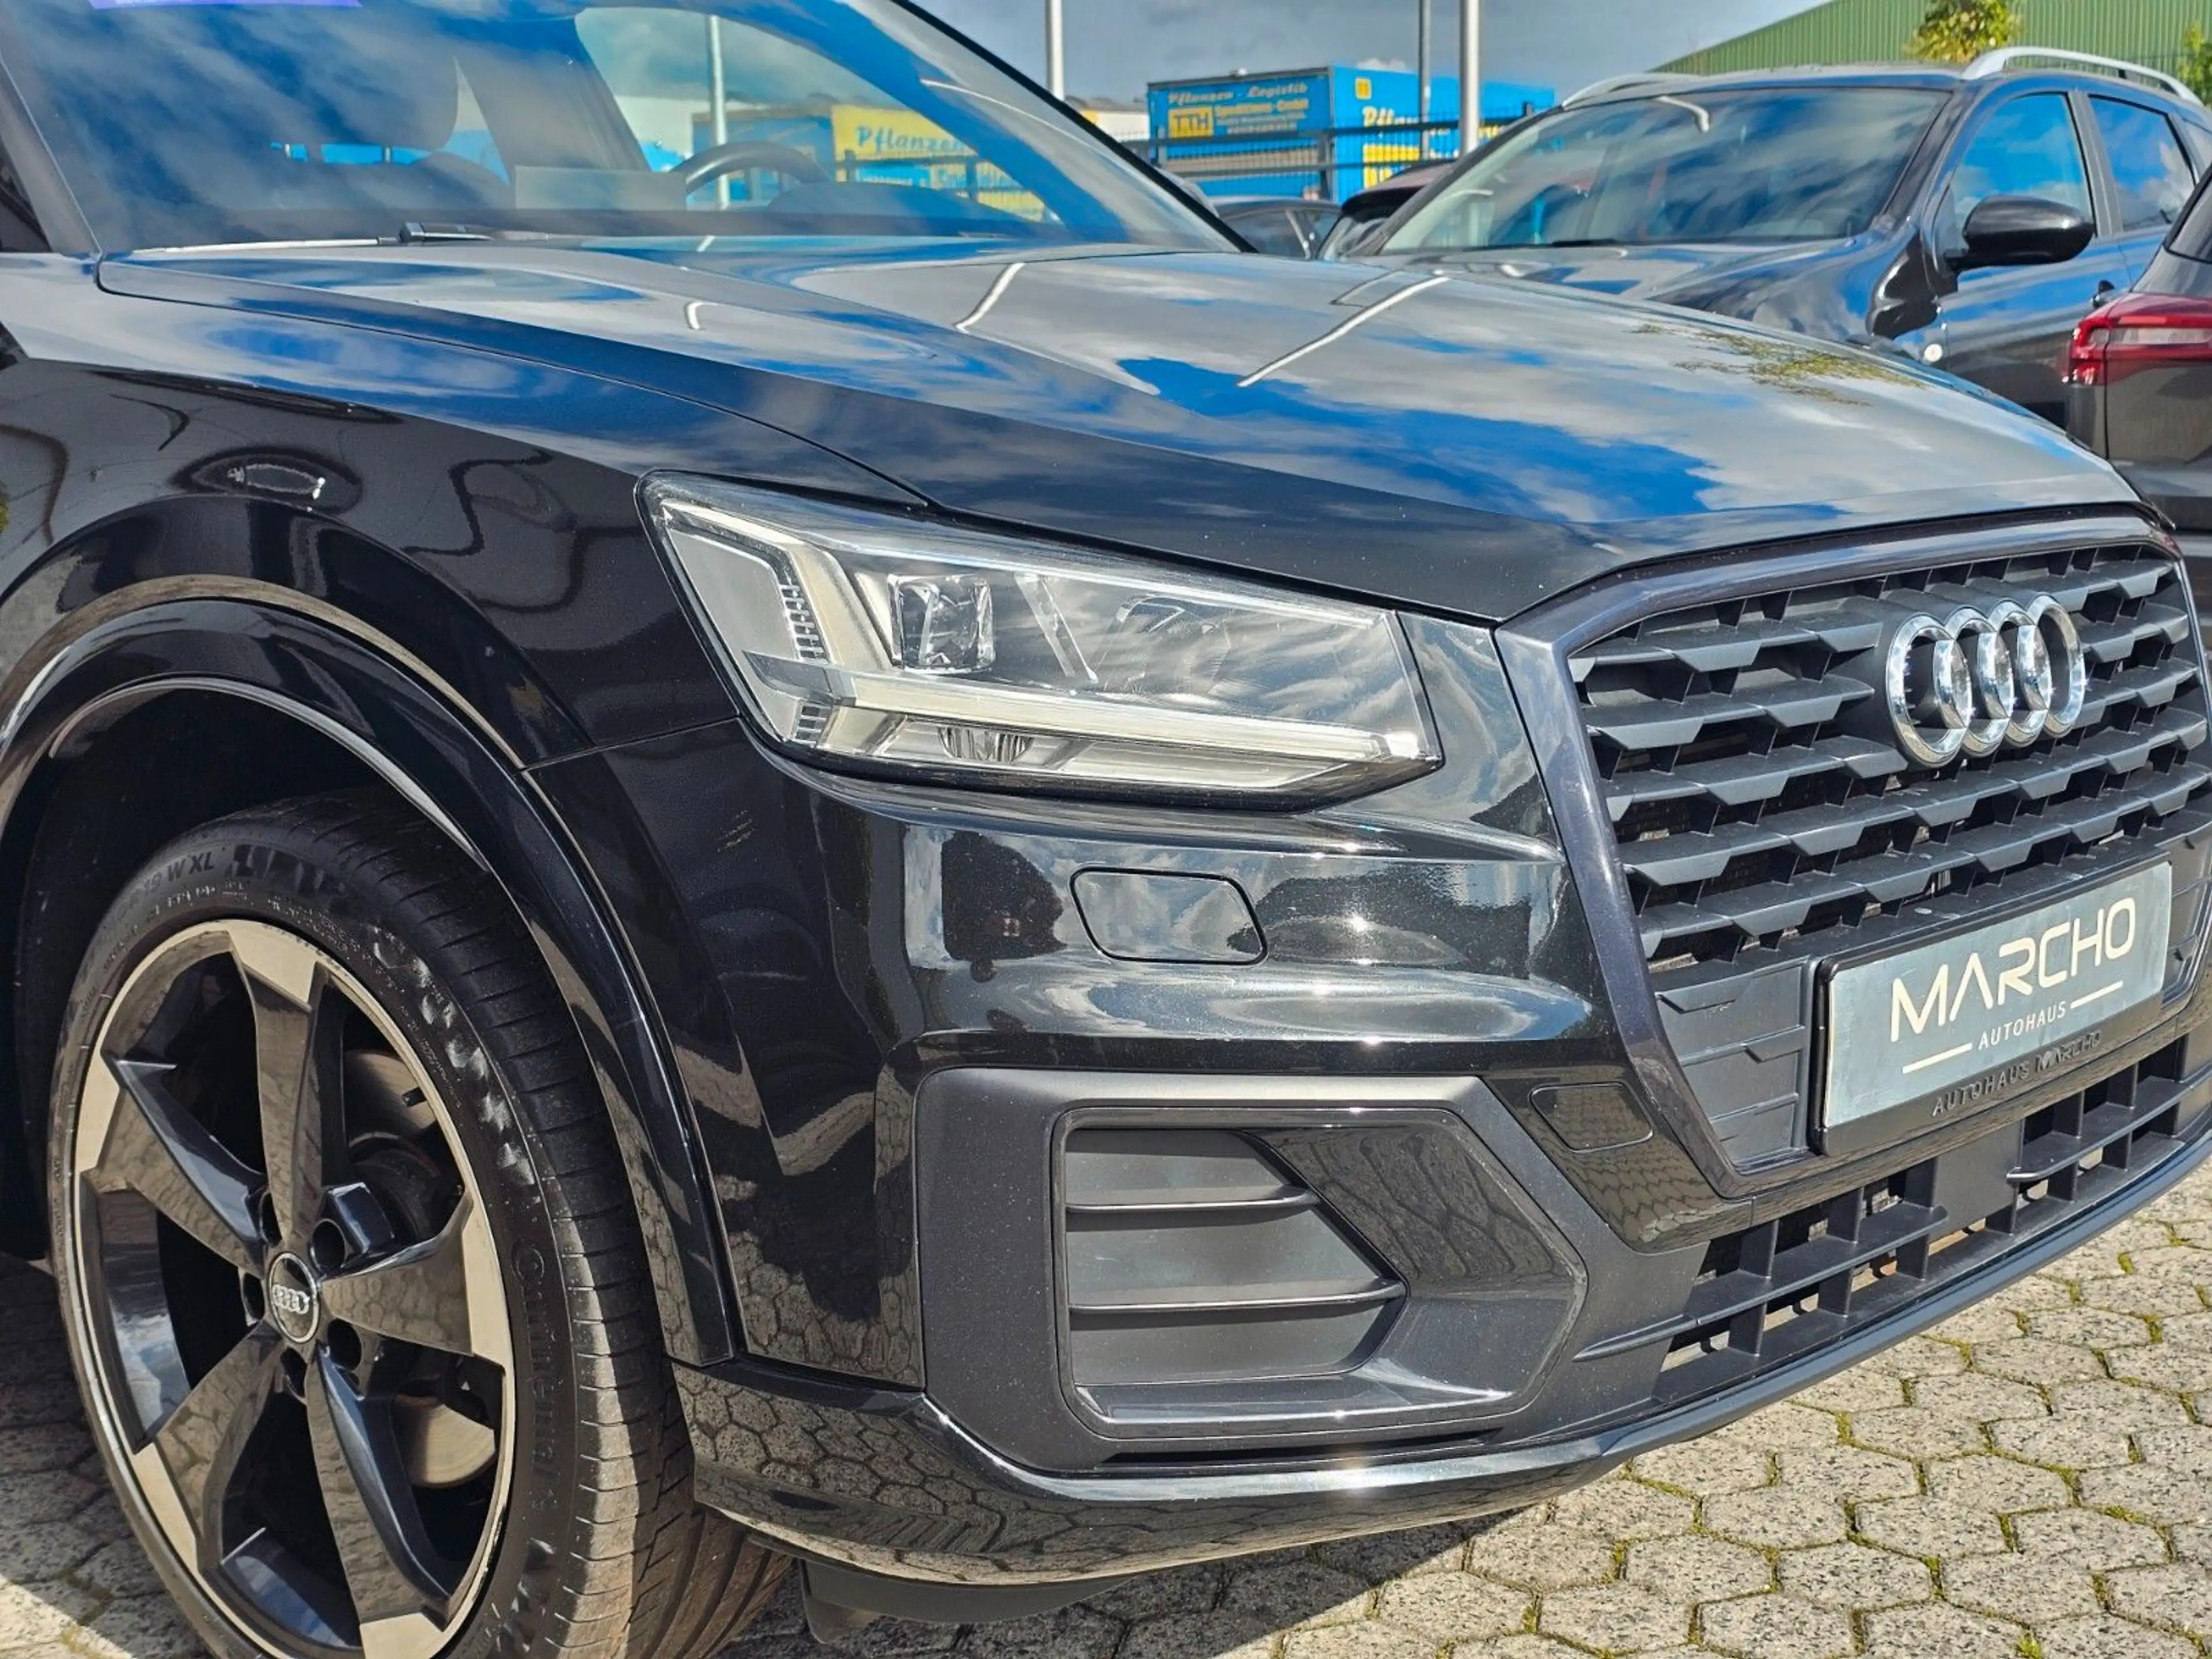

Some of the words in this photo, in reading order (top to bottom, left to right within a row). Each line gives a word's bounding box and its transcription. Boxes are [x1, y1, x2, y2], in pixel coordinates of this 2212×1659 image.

[189, 851, 214, 874] XL
[1891, 897, 2136, 1042] MARCHO
[1978, 1001, 2067, 1051] AUTOHAUS
[1932, 1060, 2030, 1116] AUTOHAUS
[2036, 1030, 2101, 1073] MARCHO
